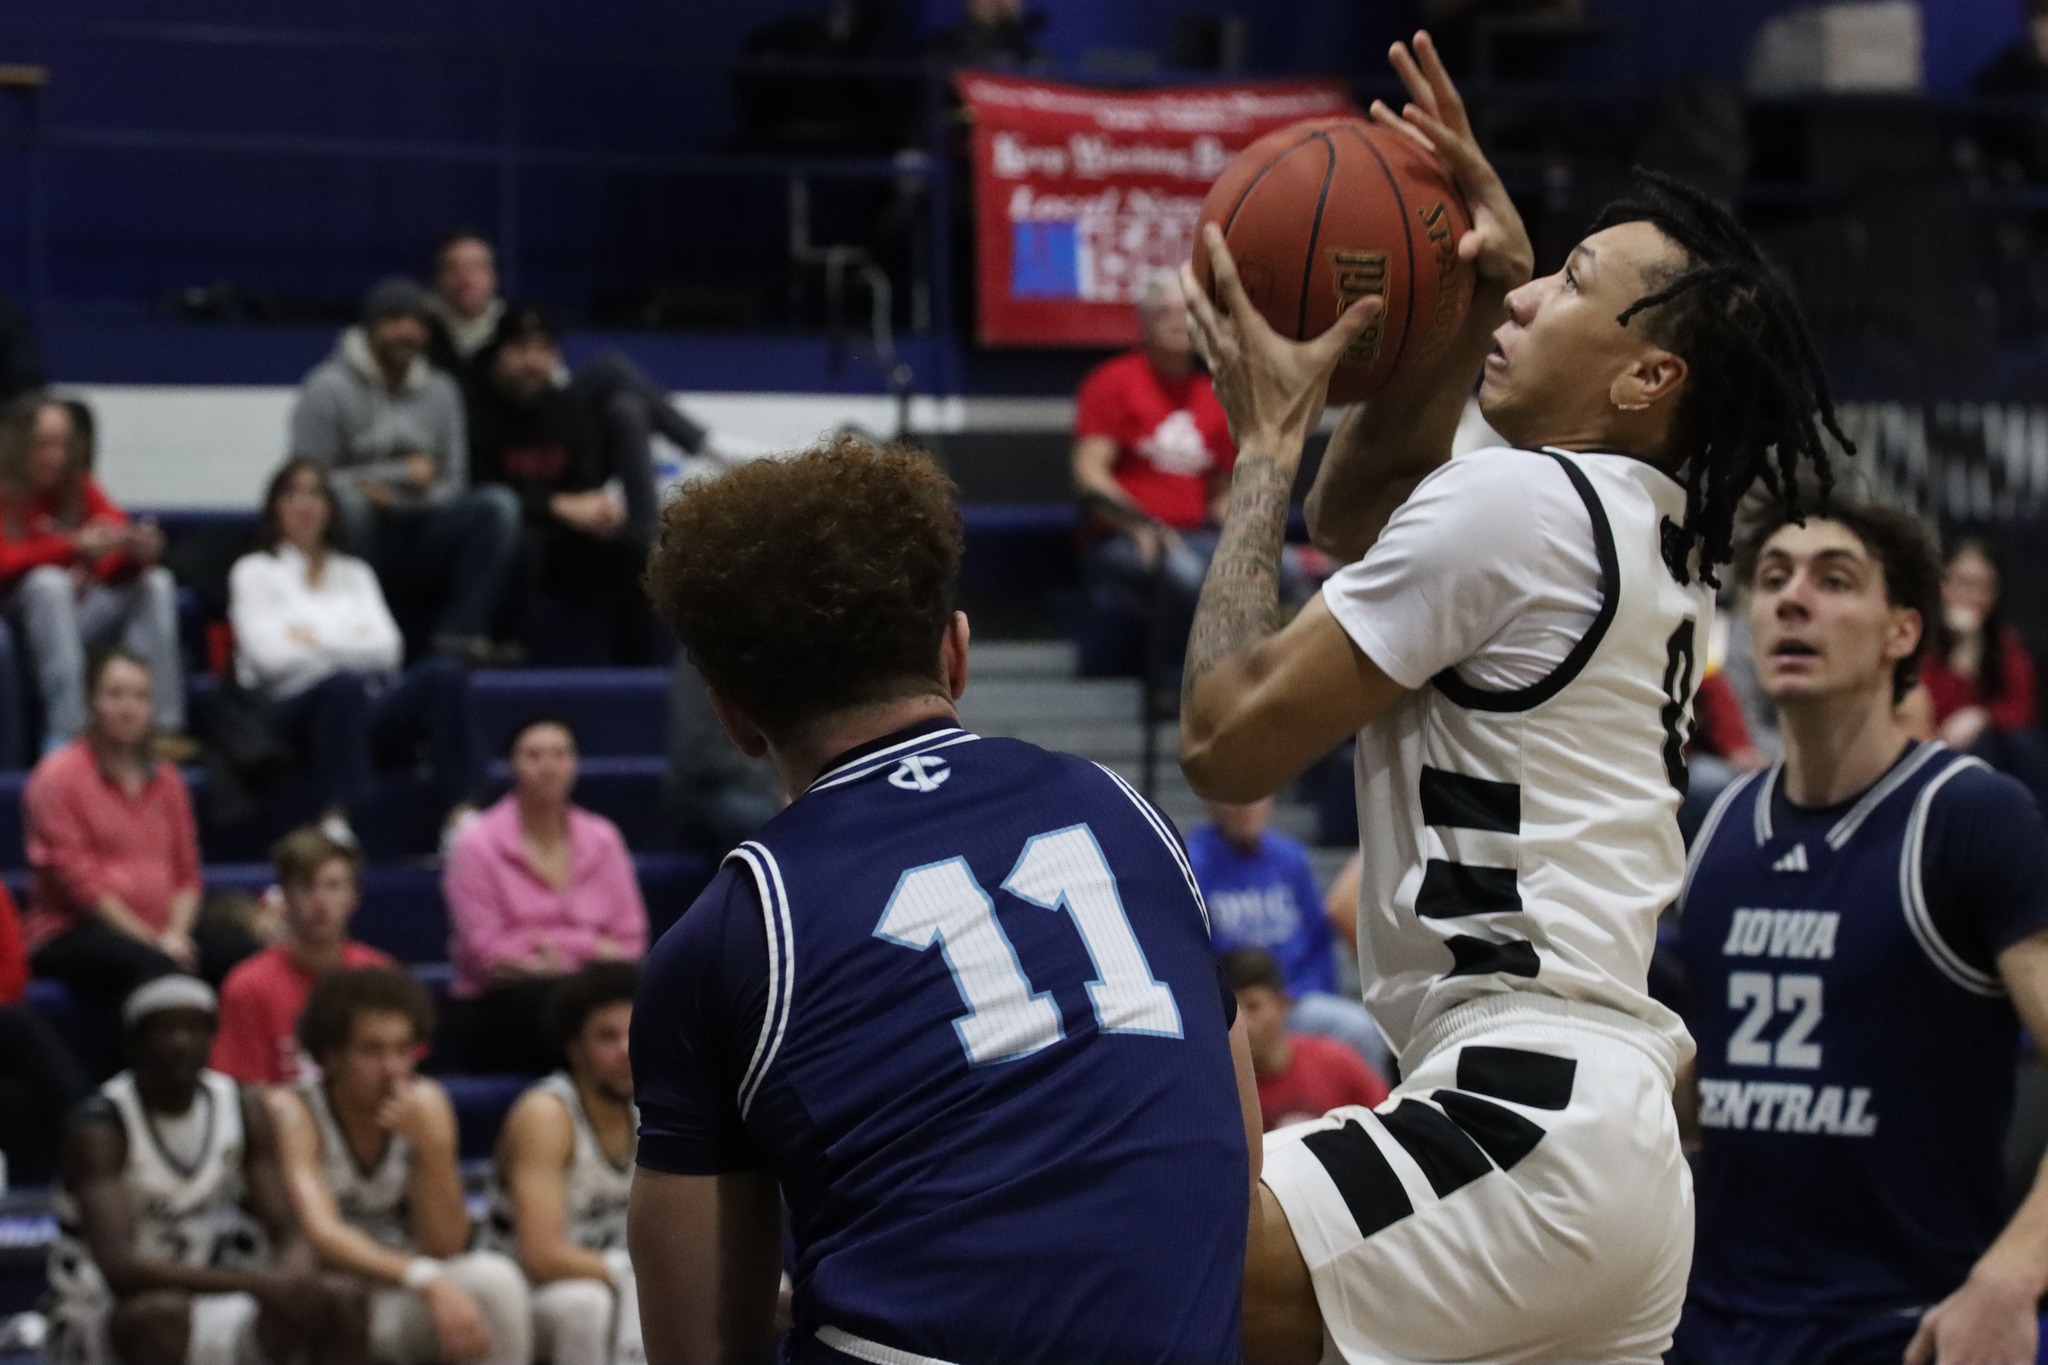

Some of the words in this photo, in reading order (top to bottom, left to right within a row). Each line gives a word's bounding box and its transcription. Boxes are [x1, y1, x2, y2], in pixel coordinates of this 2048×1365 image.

[871, 822, 1185, 1070] 11
[1722, 907, 1840, 959] IOWA
[1726, 971, 1824, 1070] 22
[1697, 1078, 1878, 1137] ENTRAL
